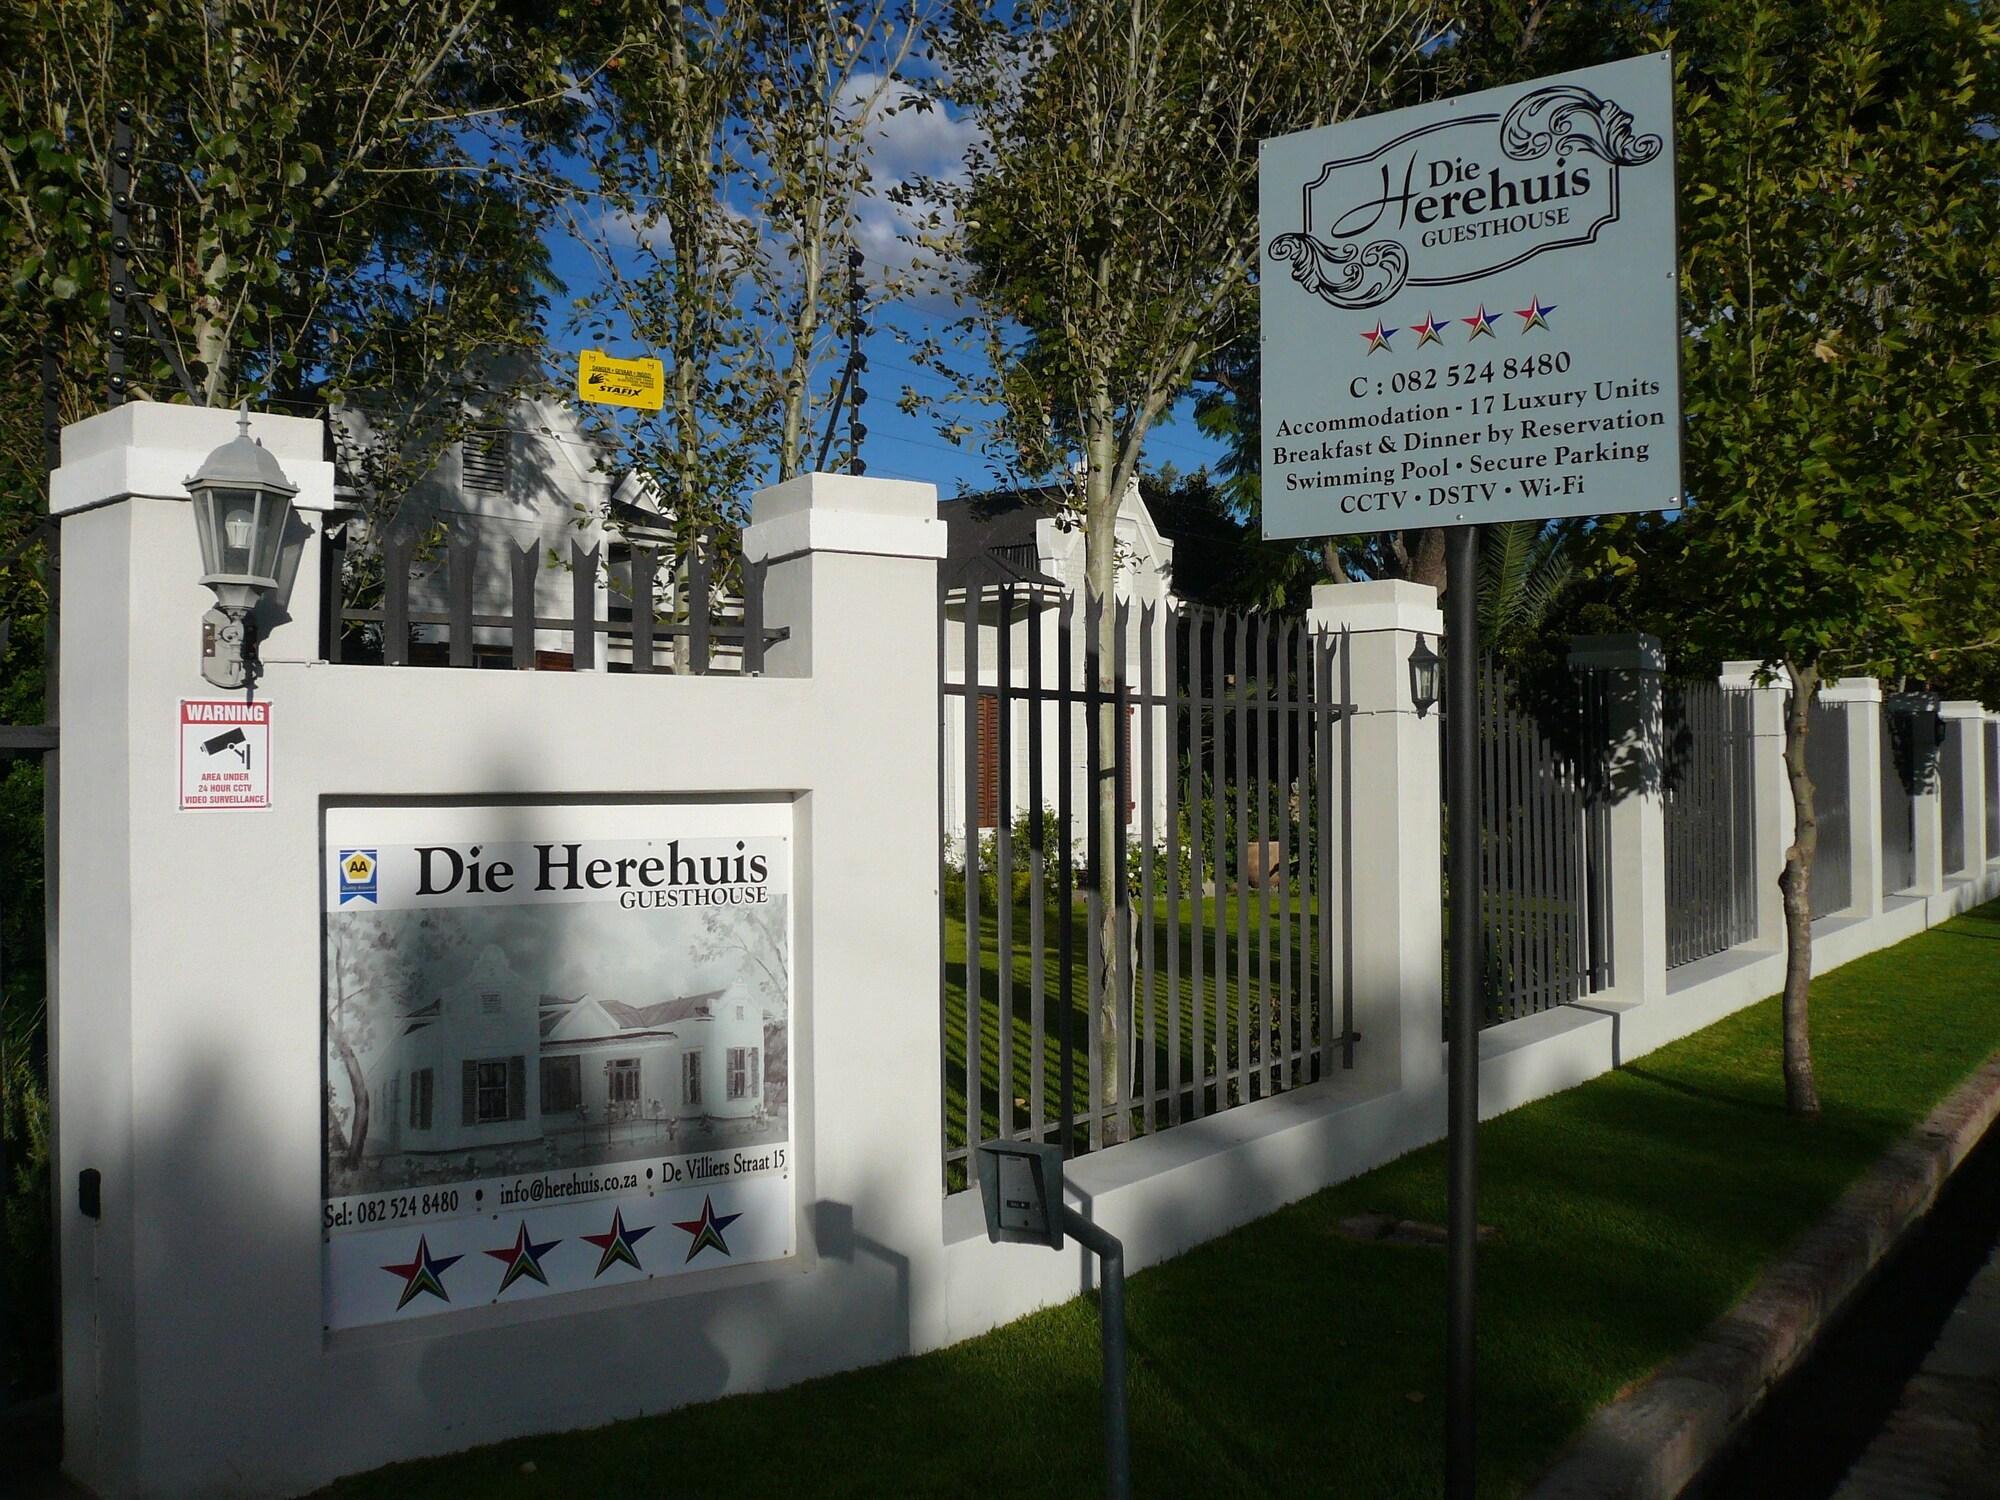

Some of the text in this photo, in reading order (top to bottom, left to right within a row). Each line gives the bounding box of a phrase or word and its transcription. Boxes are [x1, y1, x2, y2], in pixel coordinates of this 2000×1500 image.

[1428, 156, 1481, 188] Die
[1331, 149, 1592, 239] Herehuis
[1421, 207, 1570, 248] GUESTHOUSE
[599, 385, 643, 397] STAFIX
[1391, 368, 1437, 395] 082
[1446, 360, 1495, 389] 524
[1502, 351, 1571, 381] 8480
[1276, 404, 1449, 438] Accommodation
[1470, 396, 1495, 416] 17
[1503, 388, 1588, 413] Luxury
[1594, 377, 1661, 401] Units
[1272, 410, 1666, 466] Breakfast & Dinner by Reservation
[1286, 440, 1650, 492] Swimming Pool Secure Parking
[1340, 475, 1585, 515] CCTV DSTV Wi-Fi
[186, 704, 265, 722] WARNING
[198, 784, 252, 793] 24 HOUR CCTV
[201, 773, 249, 781] AREA UNDER
[185, 795, 265, 804] VIDEO SURVEILLANCE
[349, 860, 368, 873] AA
[414, 839, 768, 896] Die Herehuis
[619, 886, 769, 910] GUESTHOUSE
[324, 1149, 785, 1229] Sel: 082 524 8480 info@herehuis.co.za De Villiers Straat 15
